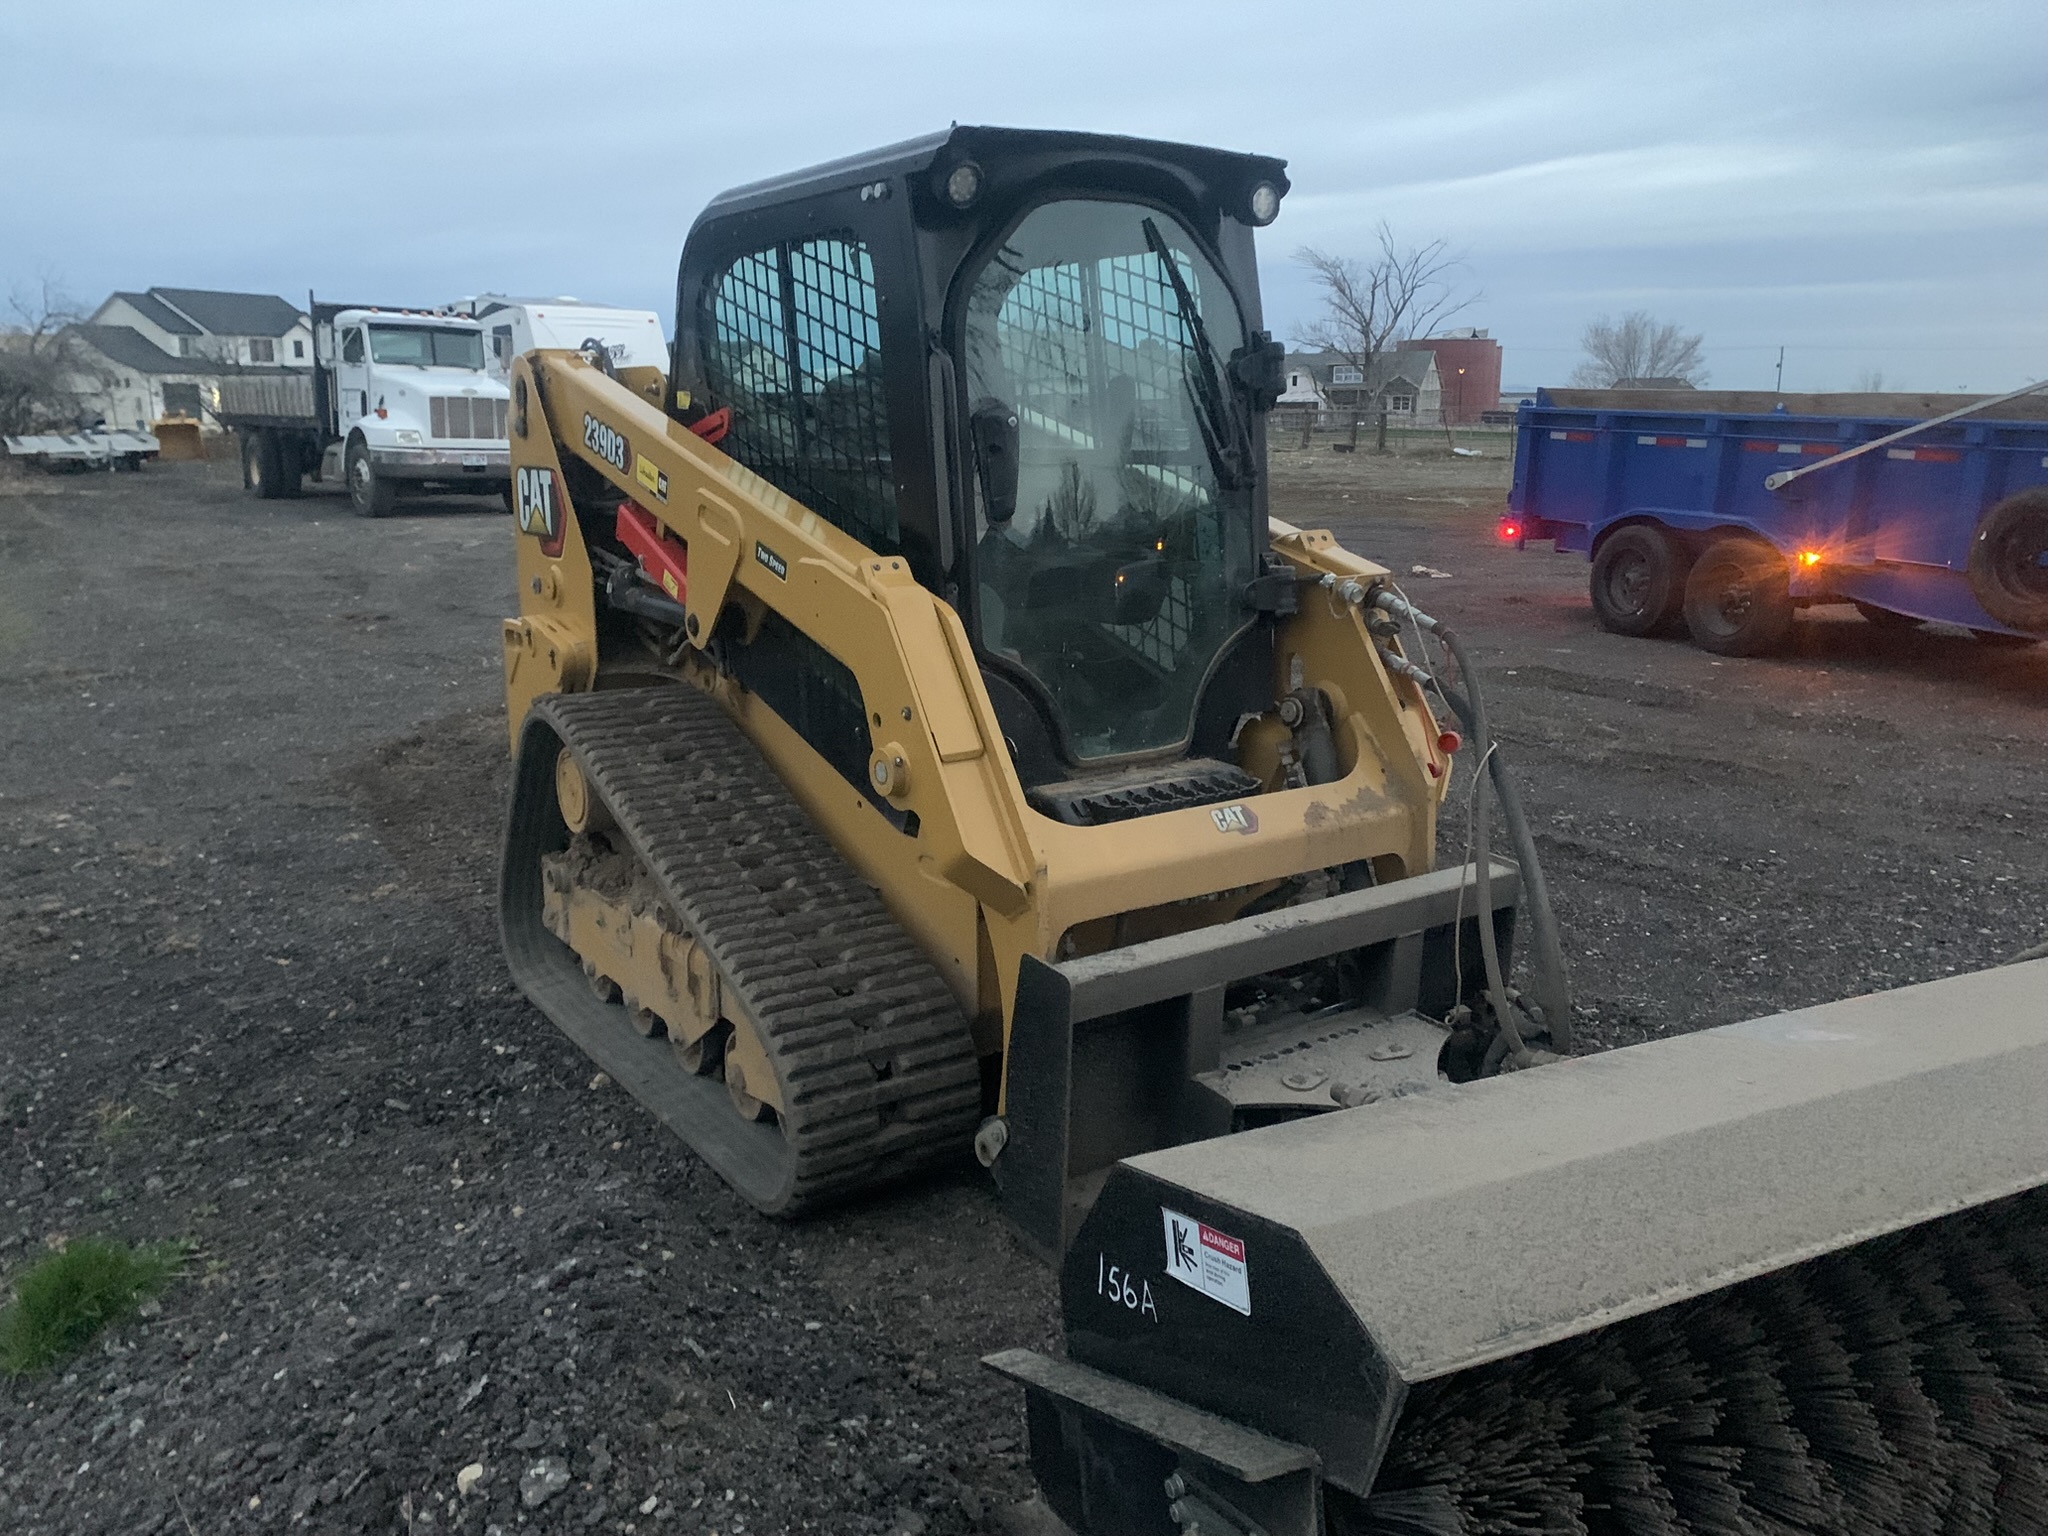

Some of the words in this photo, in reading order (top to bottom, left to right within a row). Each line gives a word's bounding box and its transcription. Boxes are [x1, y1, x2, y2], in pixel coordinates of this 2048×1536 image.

[583, 414, 625, 470] 239D3
[517, 467, 553, 536] CAT
[1210, 805, 1249, 832] CAT
[1208, 1232, 1240, 1255] DANGER
[1098, 1251, 1158, 1324] 156A
